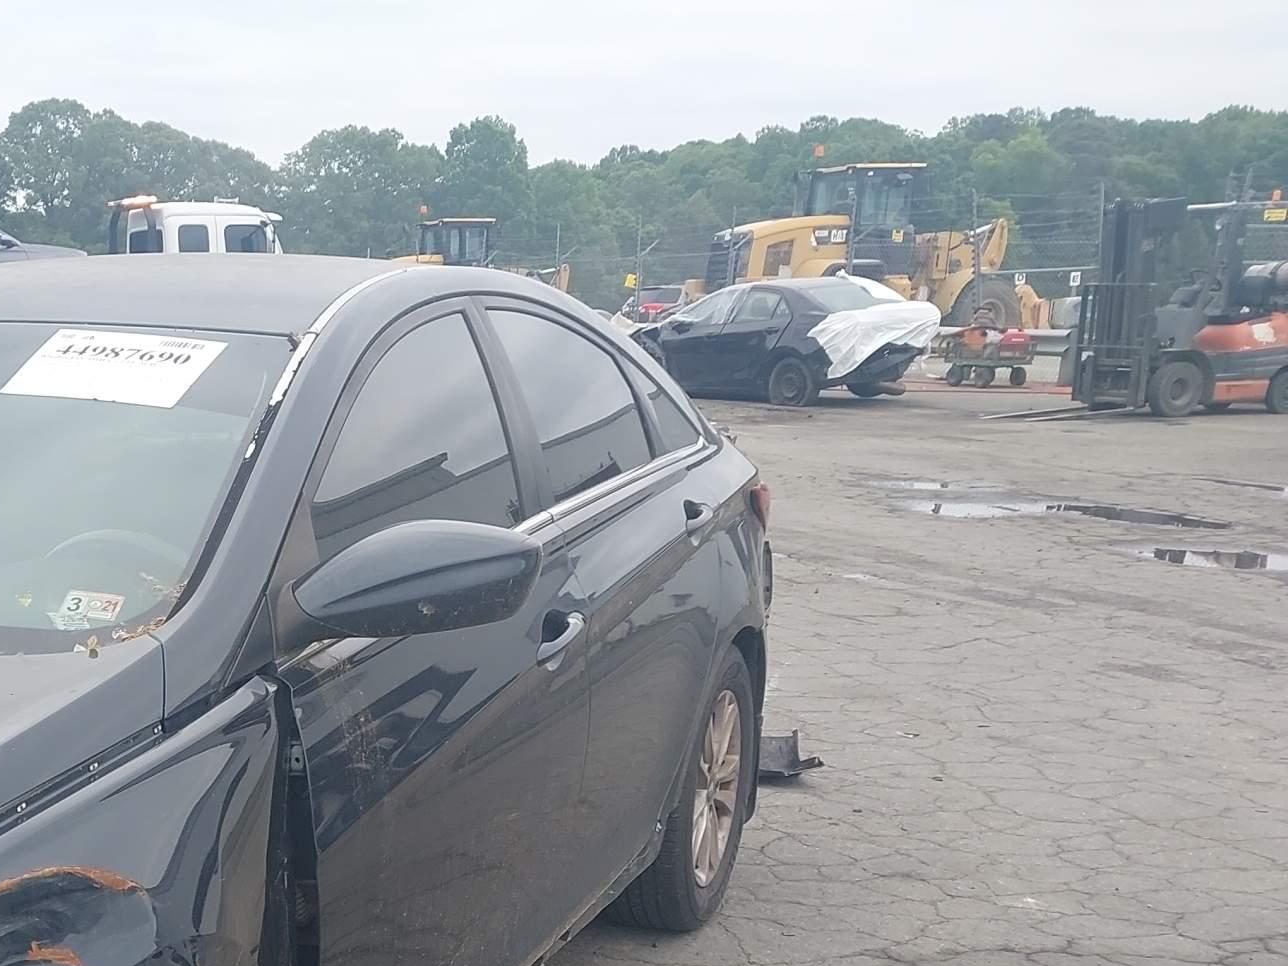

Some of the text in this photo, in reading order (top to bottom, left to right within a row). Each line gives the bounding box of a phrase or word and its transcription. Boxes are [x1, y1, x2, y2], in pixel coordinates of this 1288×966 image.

[831, 229, 848, 242] CAT
[56, 344, 192, 365] 44987690
[67, 597, 82, 611] 3
